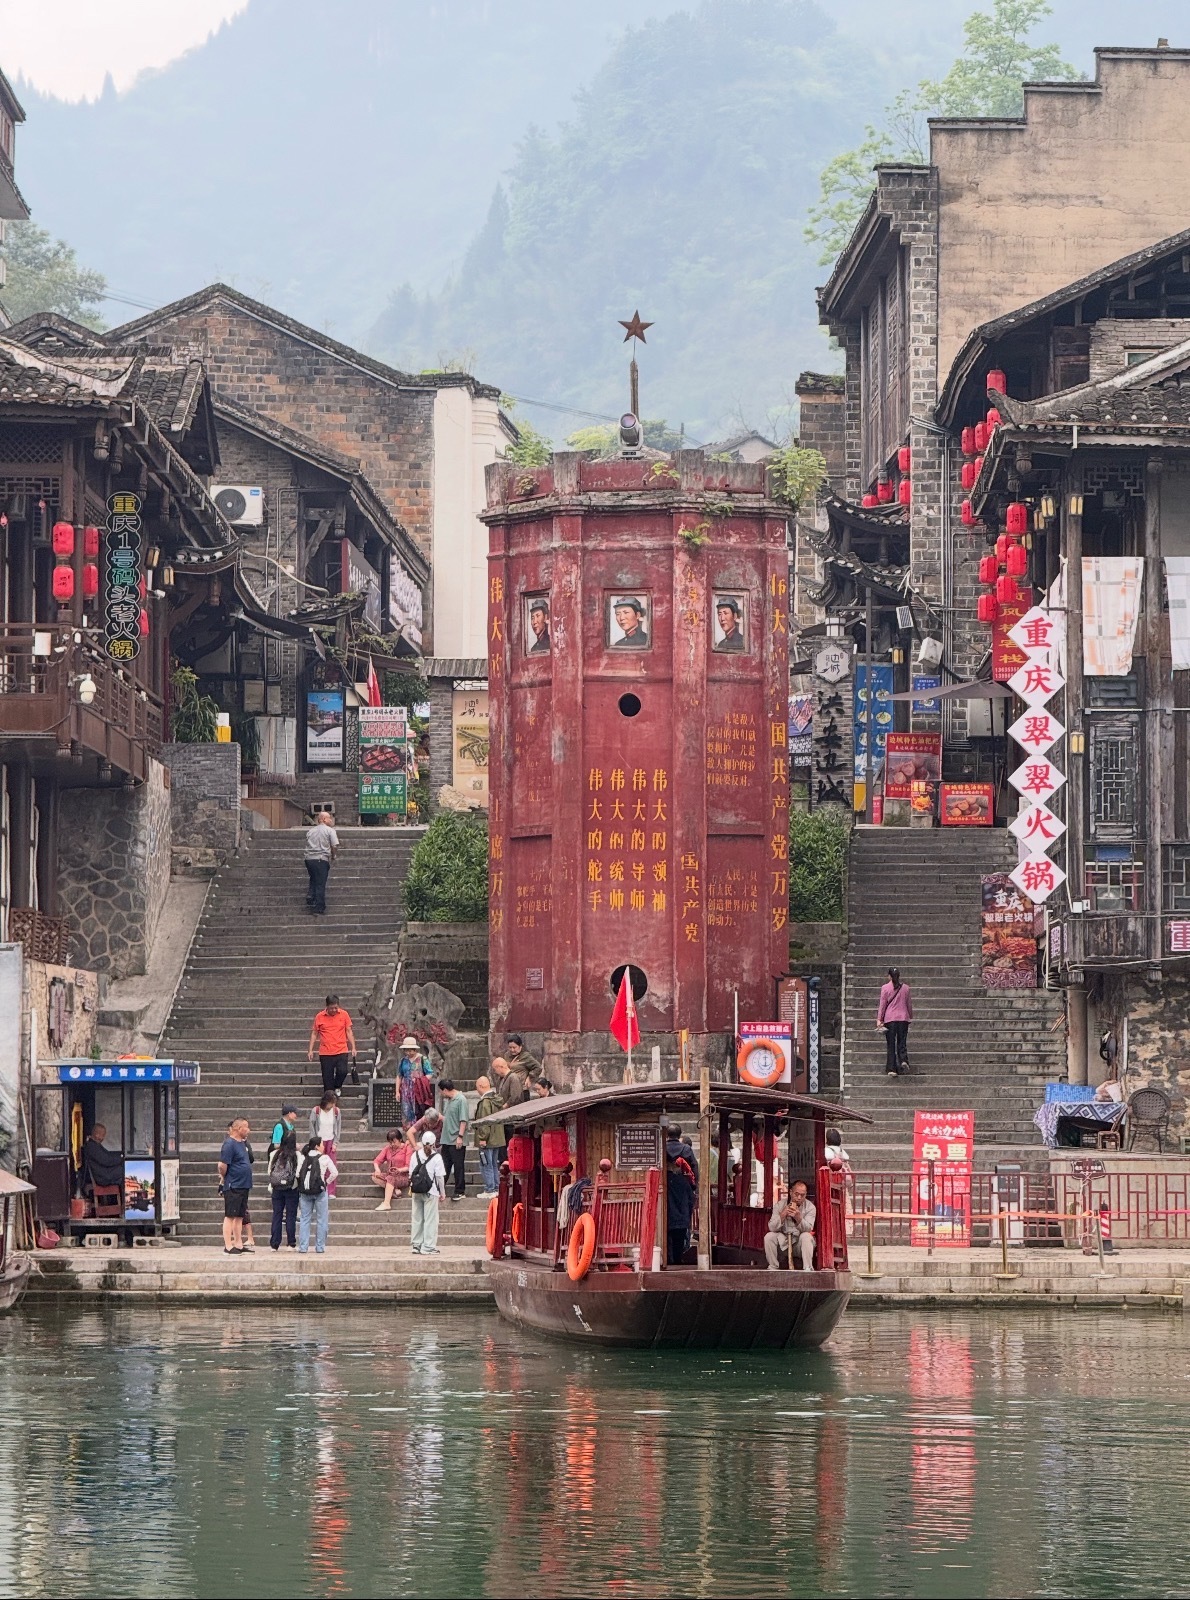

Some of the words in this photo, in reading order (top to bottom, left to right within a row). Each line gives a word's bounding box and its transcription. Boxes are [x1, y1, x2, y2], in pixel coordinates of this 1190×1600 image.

[109, 495, 137, 659] 重庆1号码头老火锅
[707, 726, 756, 741] 反对的我们就
[707, 757, 756, 771] 敌人拥护的我
[724, 712, 756, 725] 凡是敌人
[1021, 616, 1056, 891] 重庆翠翠火锅
[587, 767, 604, 912] 伟大的舵手
[609, 767, 625, 912] 伟大的统帅
[630, 767, 647, 912] 伟大的导师
[652, 767, 668, 912] 伟大的领袖
[681, 851, 700, 943] 国共产党
[85, 1067, 162, 1078] 游船售票点
